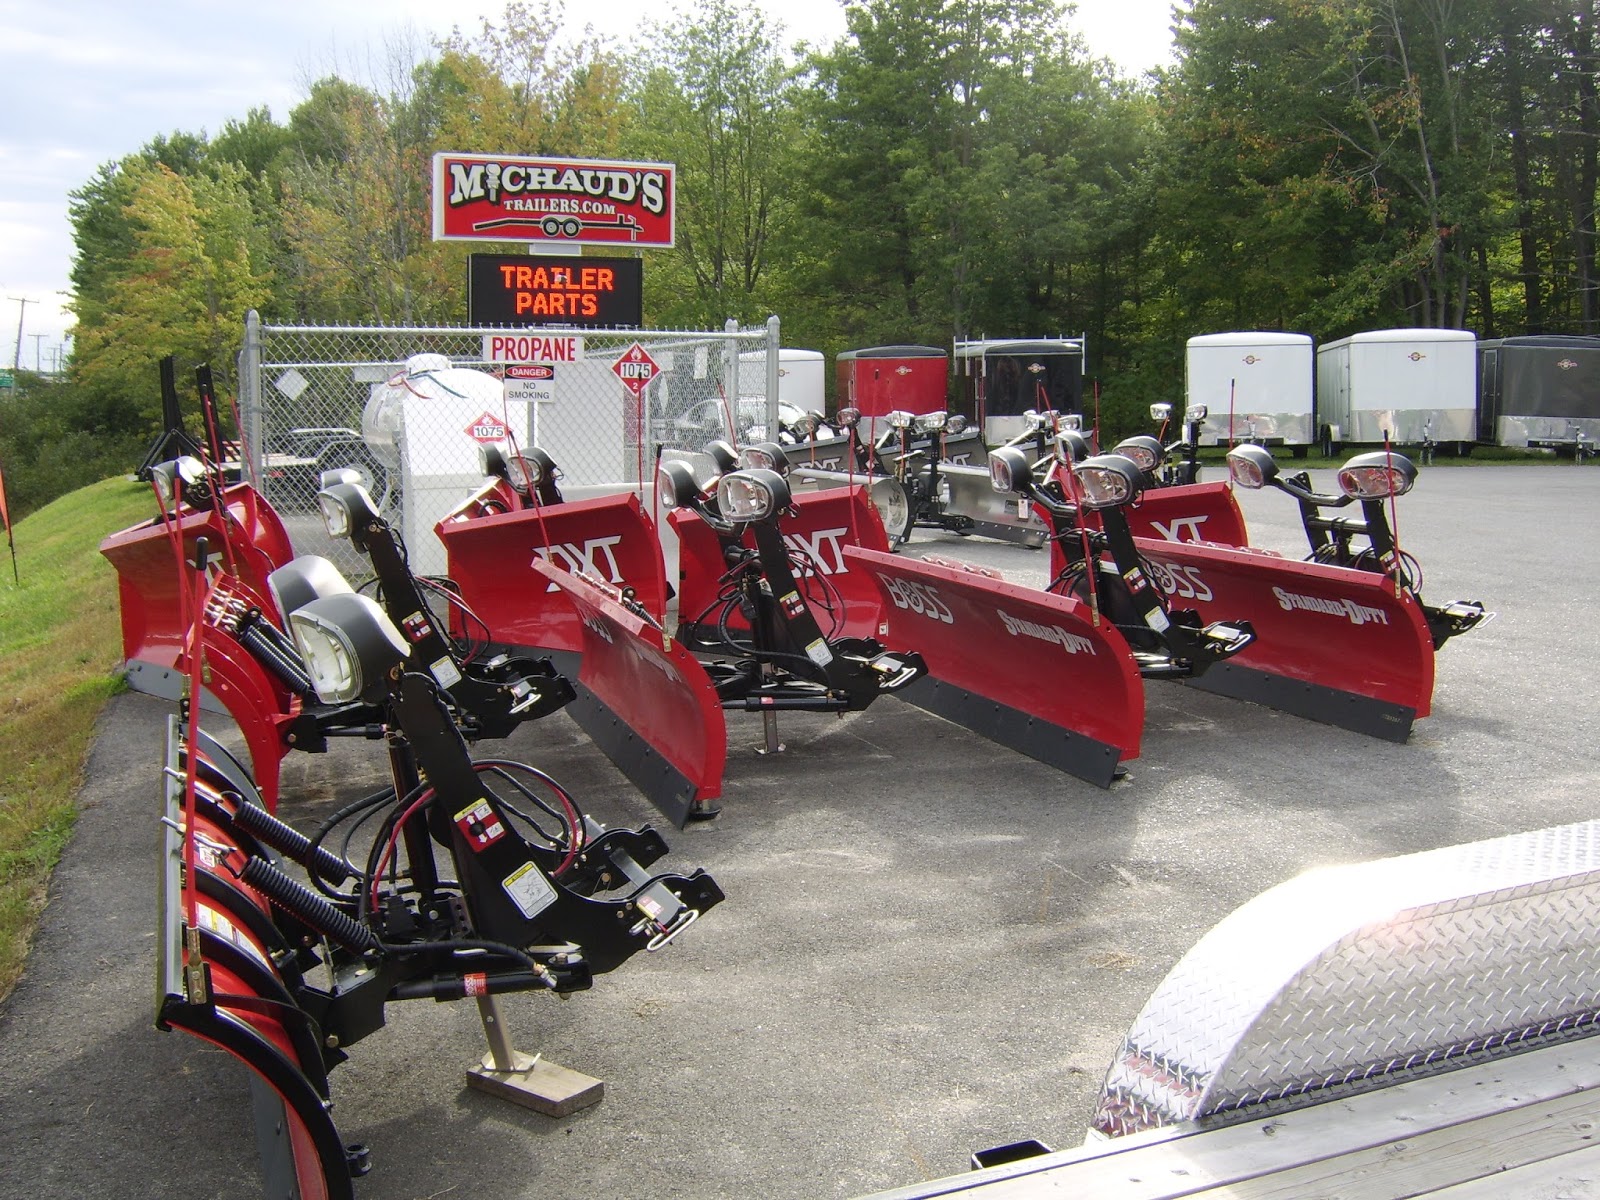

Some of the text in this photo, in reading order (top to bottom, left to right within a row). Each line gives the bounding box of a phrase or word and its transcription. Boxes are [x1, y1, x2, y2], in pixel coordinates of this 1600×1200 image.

[504, 199, 616, 215] TRAILERS.COM
[500, 265, 614, 291] TRAILER
[516, 292, 597, 316] PARTS
[491, 337, 576, 362] PROPANE
[511, 367, 548, 378] DANGER
[622, 363, 651, 379] 1075
[522, 382, 536, 390] NO
[632, 382, 638, 390] 2
[508, 391, 550, 400] SMOKING
[475, 426, 504, 437] 1075
[876, 572, 954, 624] BOSS
